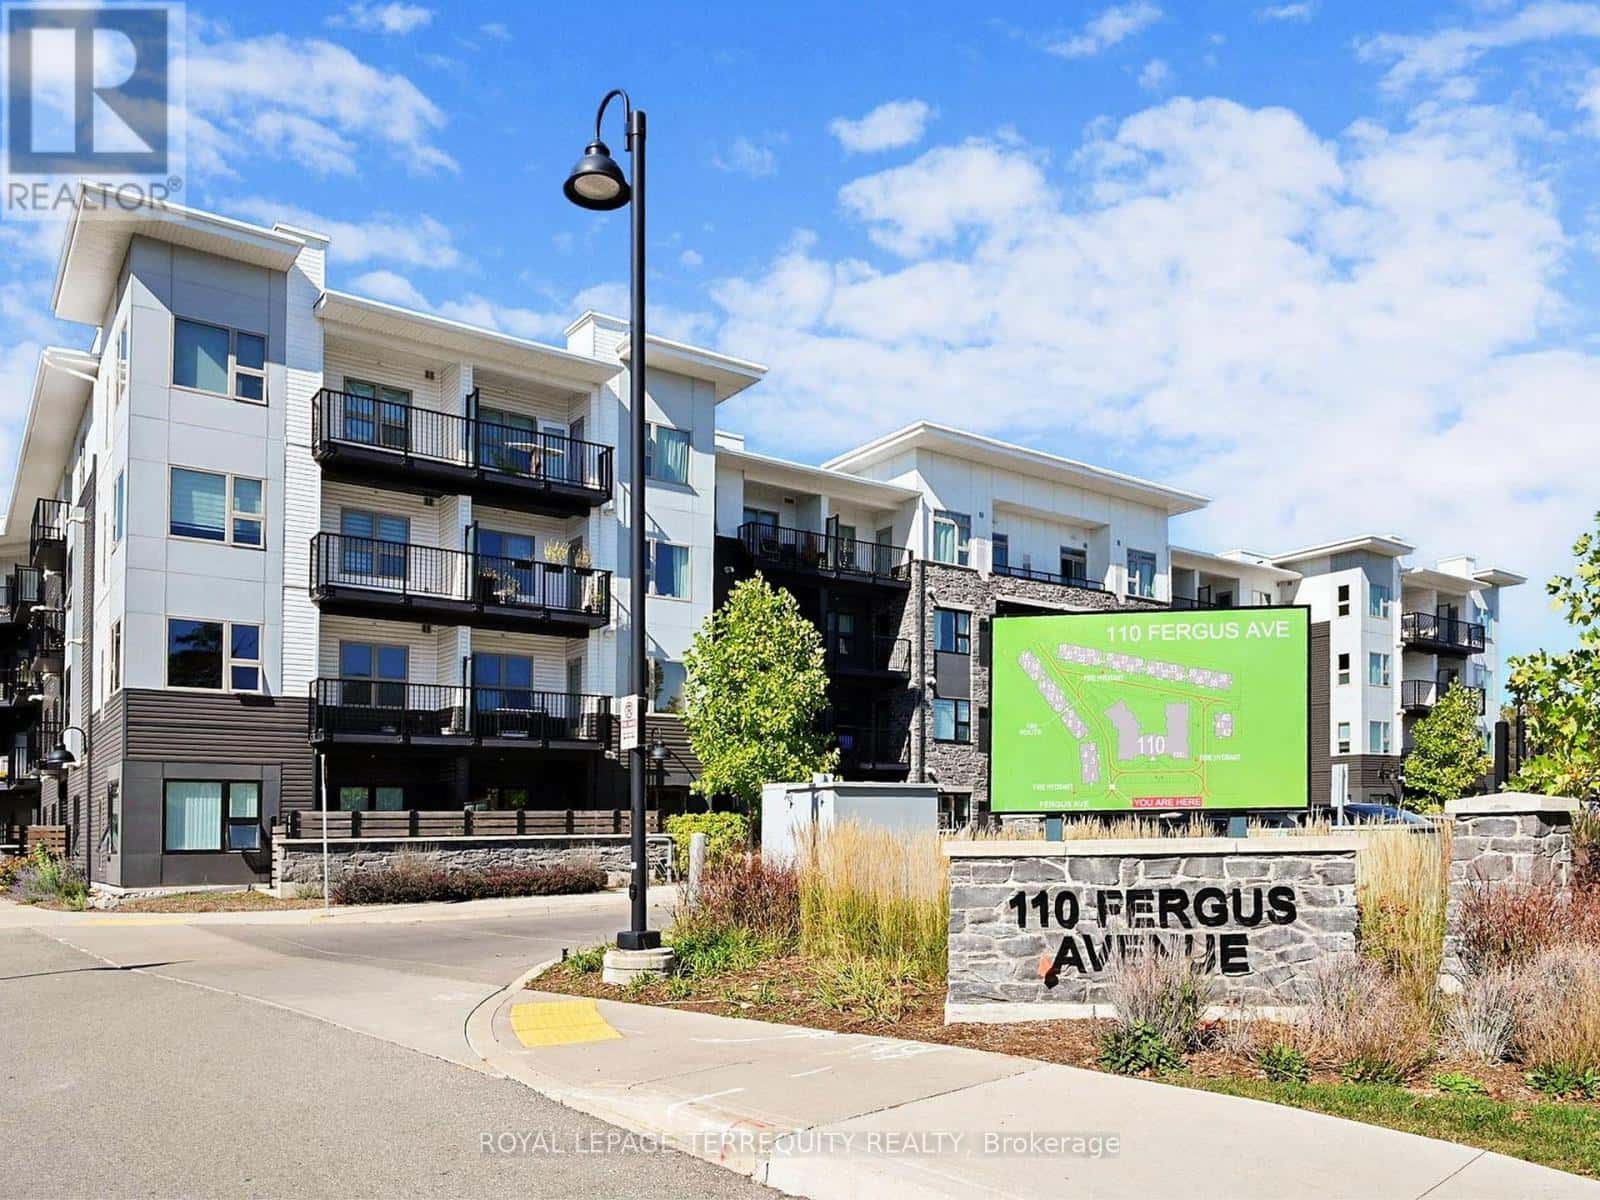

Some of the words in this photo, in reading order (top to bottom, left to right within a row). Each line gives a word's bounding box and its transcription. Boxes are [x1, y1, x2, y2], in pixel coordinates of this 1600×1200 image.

[1107, 625, 1142, 642] 110
[1149, 622, 1239, 641] FERGUS
[1246, 621, 1290, 638] AVE
[1138, 736, 1165, 754] 110
[1040, 801, 1072, 809] FERGUS
[1073, 800, 1089, 808] AVE
[1135, 799, 1153, 808] YOU
[1155, 799, 1174, 807] ARE
[1177, 798, 1201, 806] HERE
[1010, 890, 1080, 929] 110
[1097, 886, 1298, 928] FERGUS
